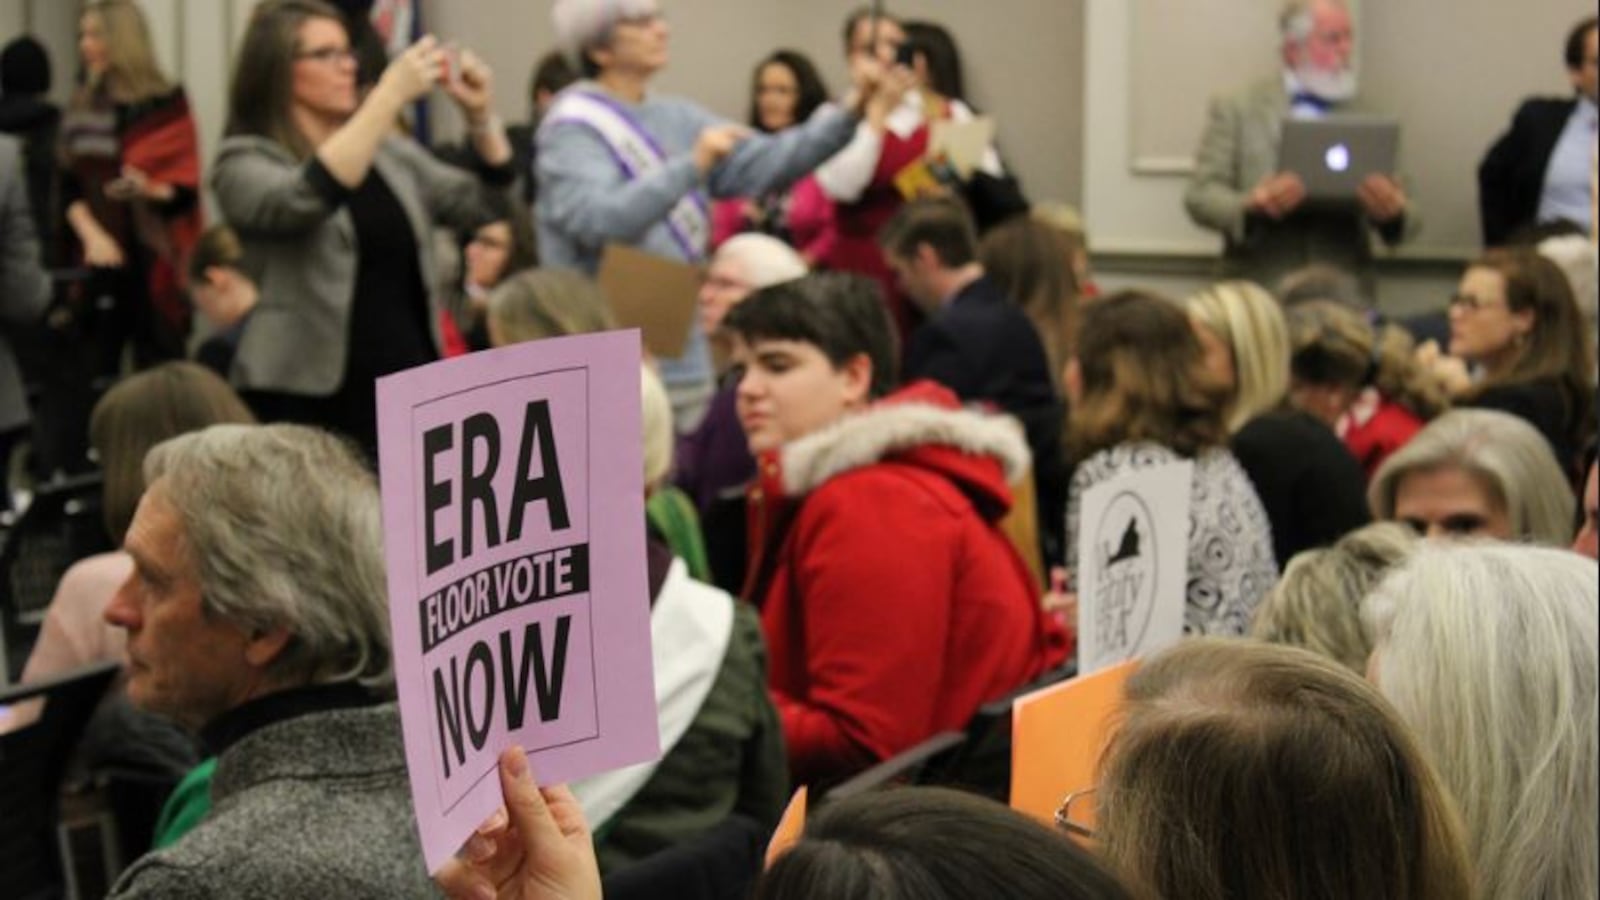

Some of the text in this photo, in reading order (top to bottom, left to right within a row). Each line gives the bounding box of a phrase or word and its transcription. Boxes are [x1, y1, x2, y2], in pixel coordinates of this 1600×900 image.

[423, 399, 570, 576] ERA
[426, 548, 573, 646] FLOOR VOTE
[433, 615, 571, 778] NOW
